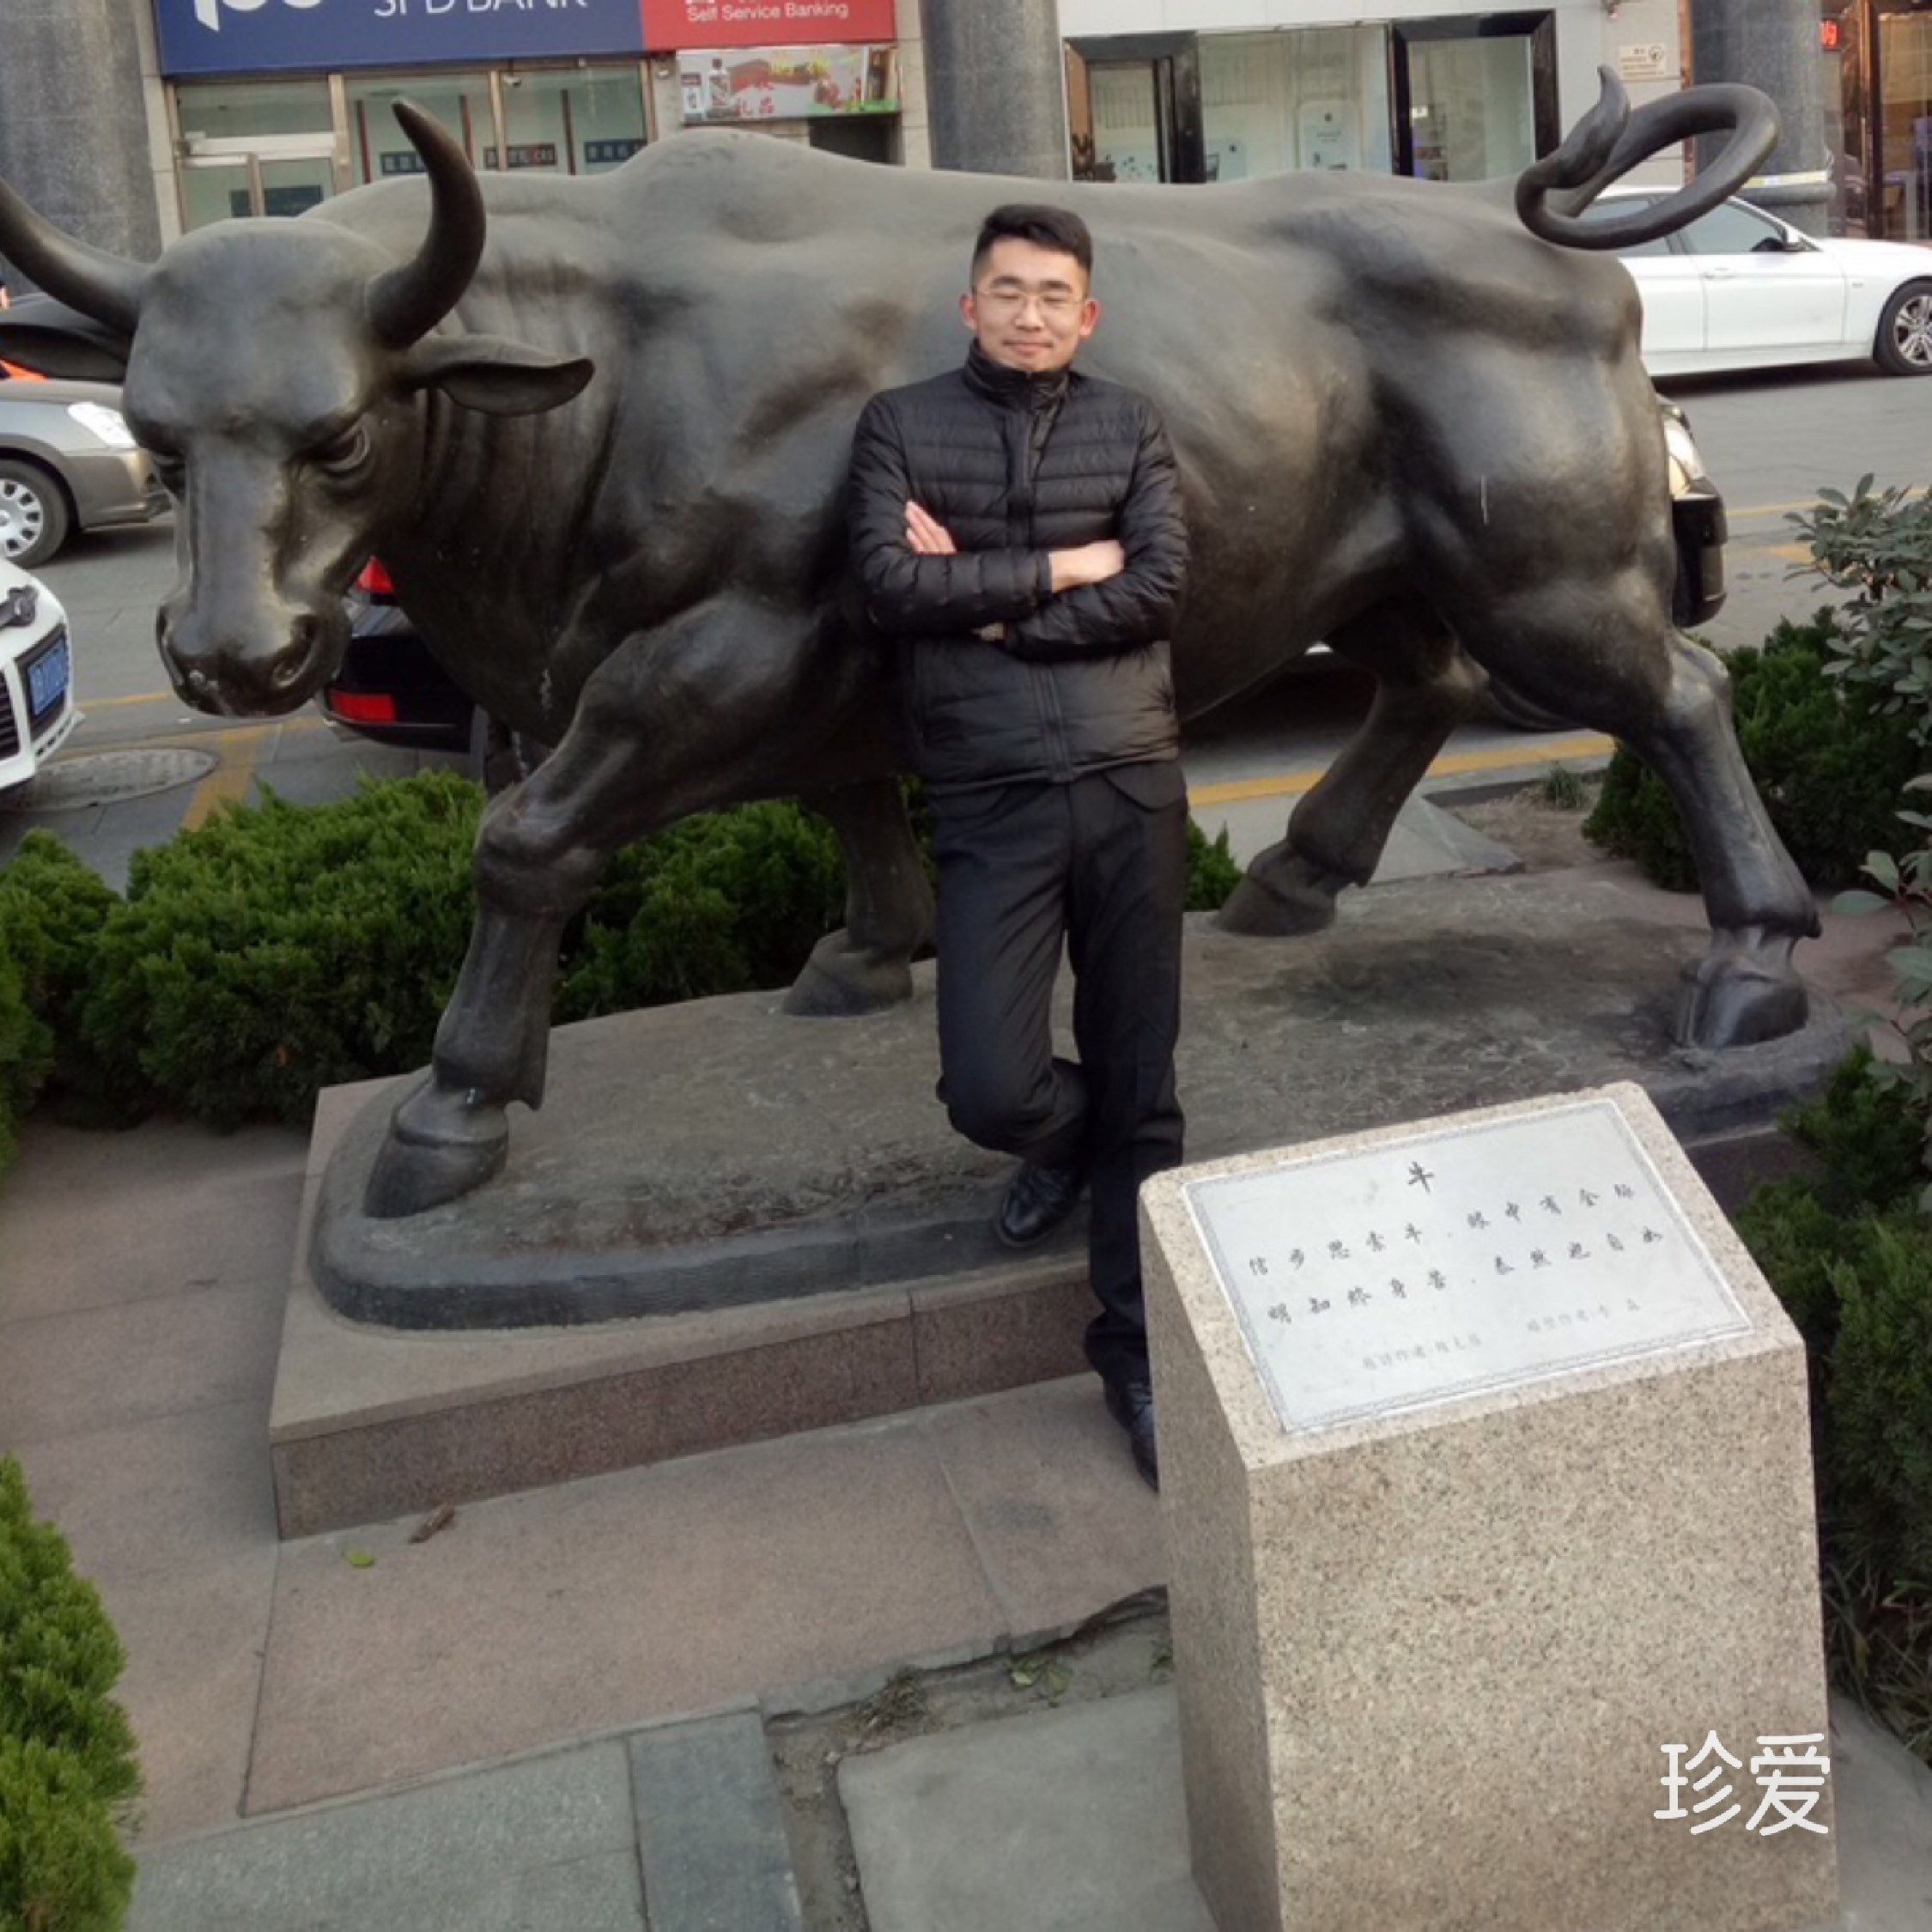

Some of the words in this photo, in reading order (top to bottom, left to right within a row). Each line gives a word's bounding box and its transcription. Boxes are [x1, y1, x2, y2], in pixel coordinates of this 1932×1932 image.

[686, 4, 718, 21] Self
[721, 3, 781, 21] Service
[784, 2, 848, 18] Banking
[1407, 1162, 1435, 1194] 牛
